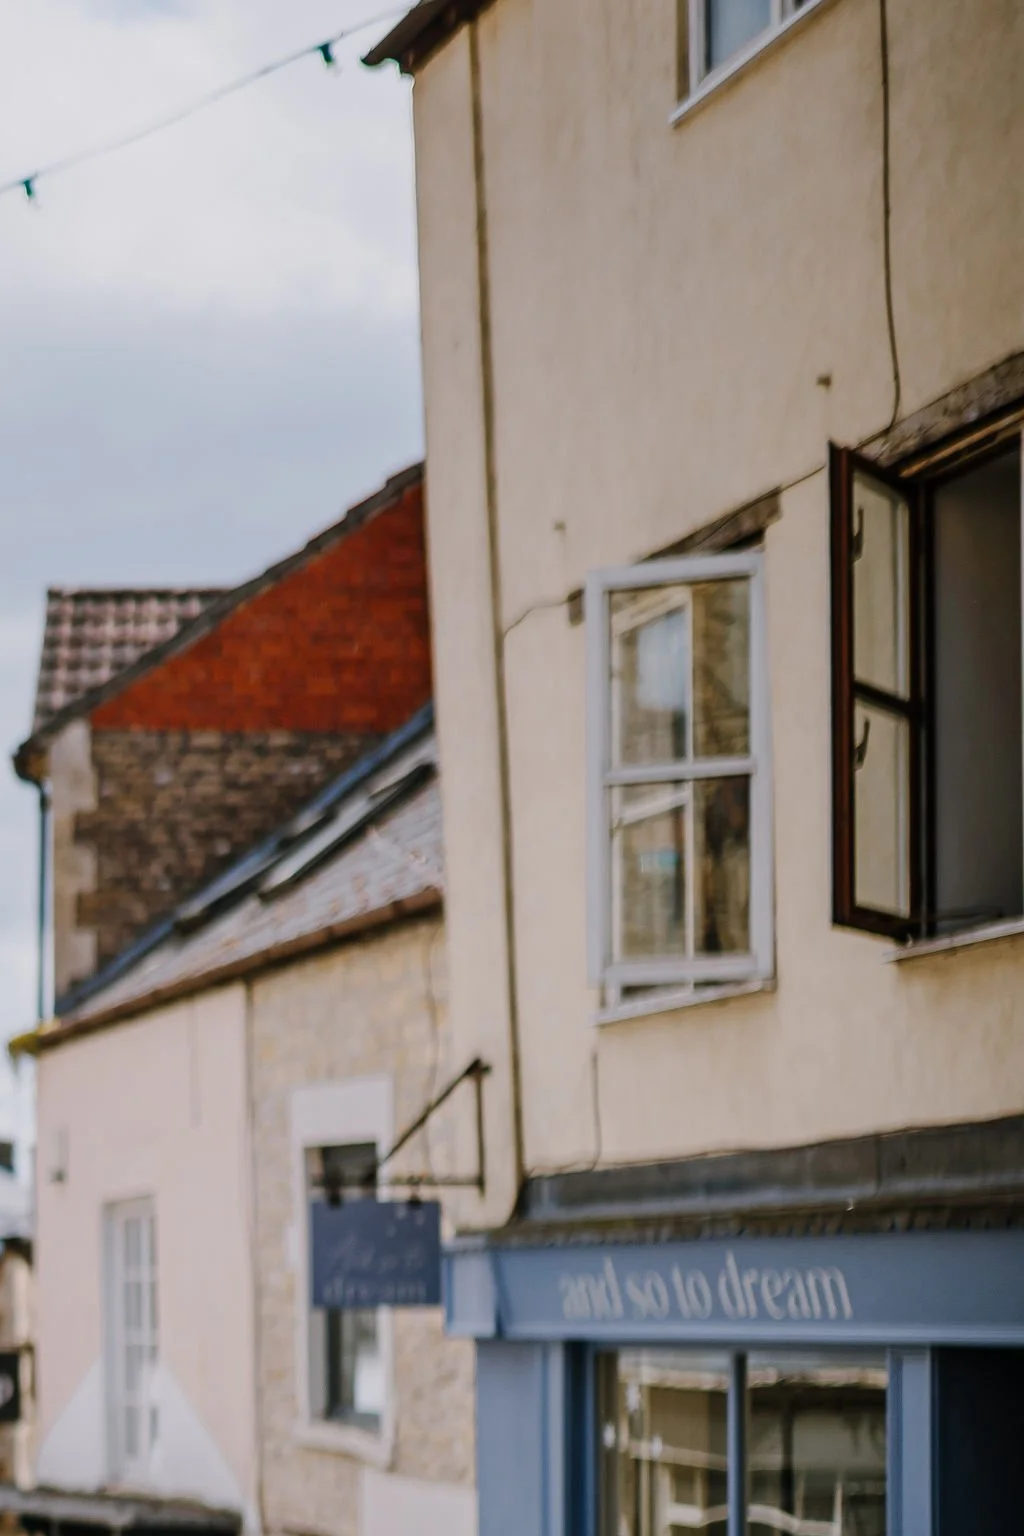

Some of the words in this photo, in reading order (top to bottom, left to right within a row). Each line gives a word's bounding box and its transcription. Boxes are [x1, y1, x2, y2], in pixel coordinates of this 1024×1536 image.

[559, 1256, 624, 1320] and
[625, 1268, 670, 1320] so
[671, 1261, 713, 1320] to
[718, 1249, 853, 1320] dream
